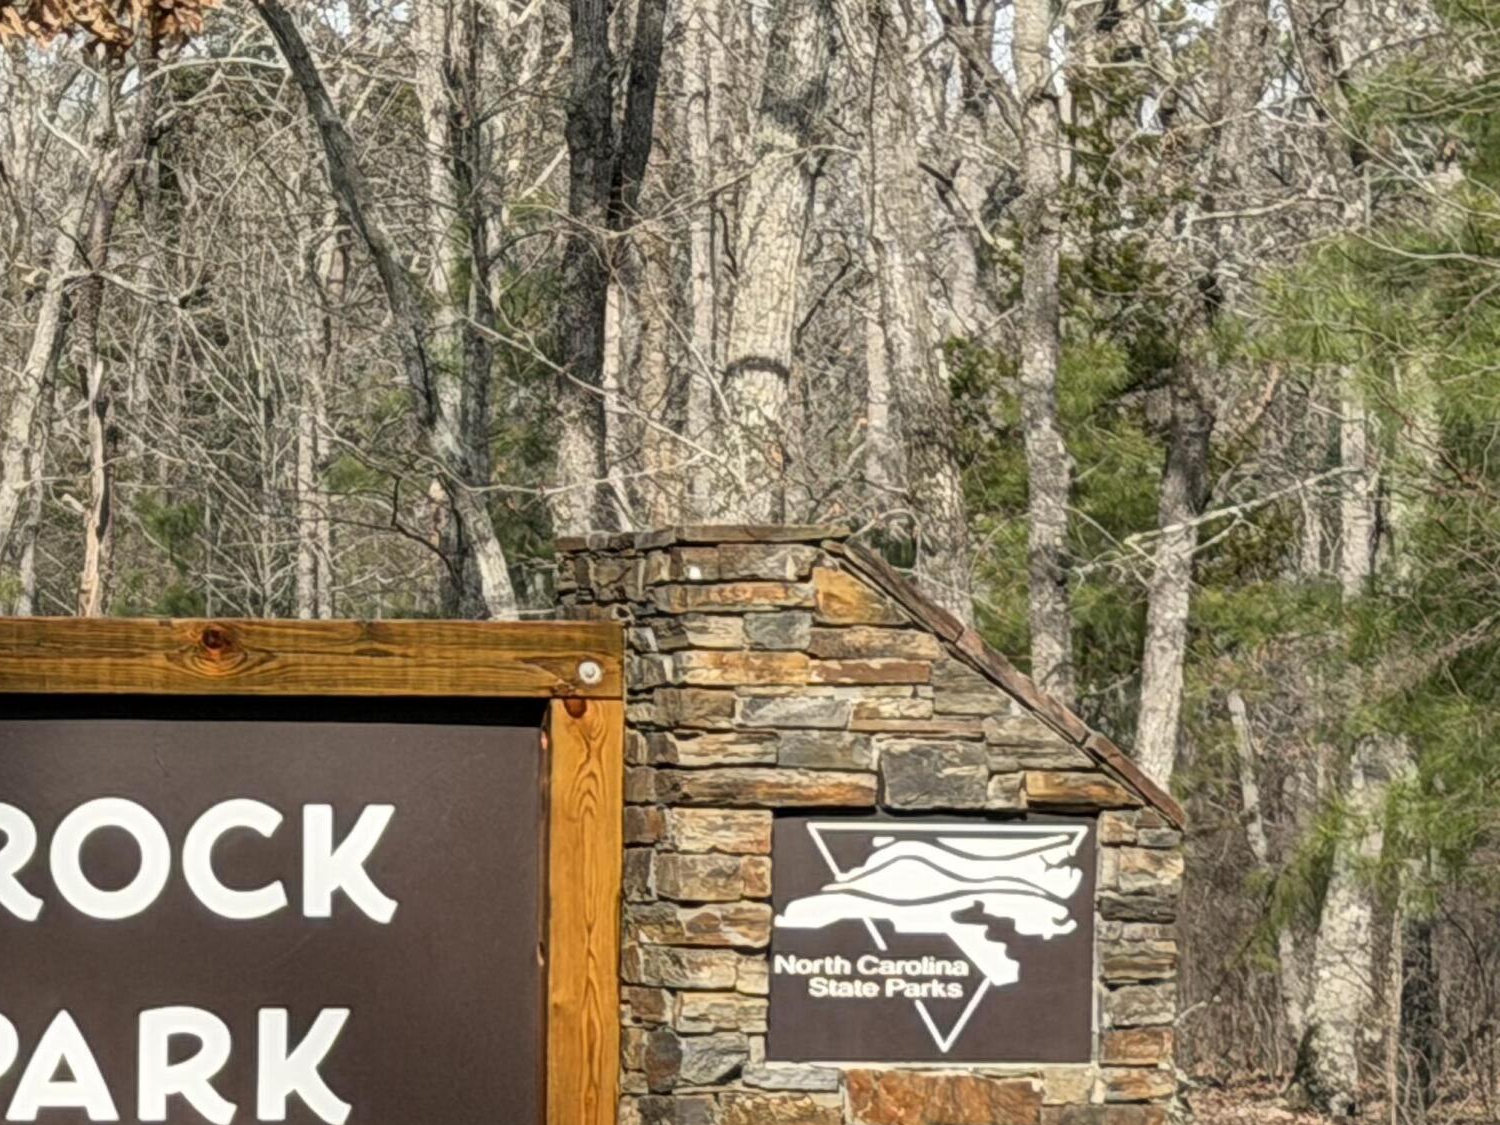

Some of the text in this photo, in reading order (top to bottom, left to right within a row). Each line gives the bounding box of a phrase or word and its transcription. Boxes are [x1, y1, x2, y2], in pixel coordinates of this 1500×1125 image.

[773, 954, 970, 977] North Carolina
[808, 976, 964, 999] State Parks
